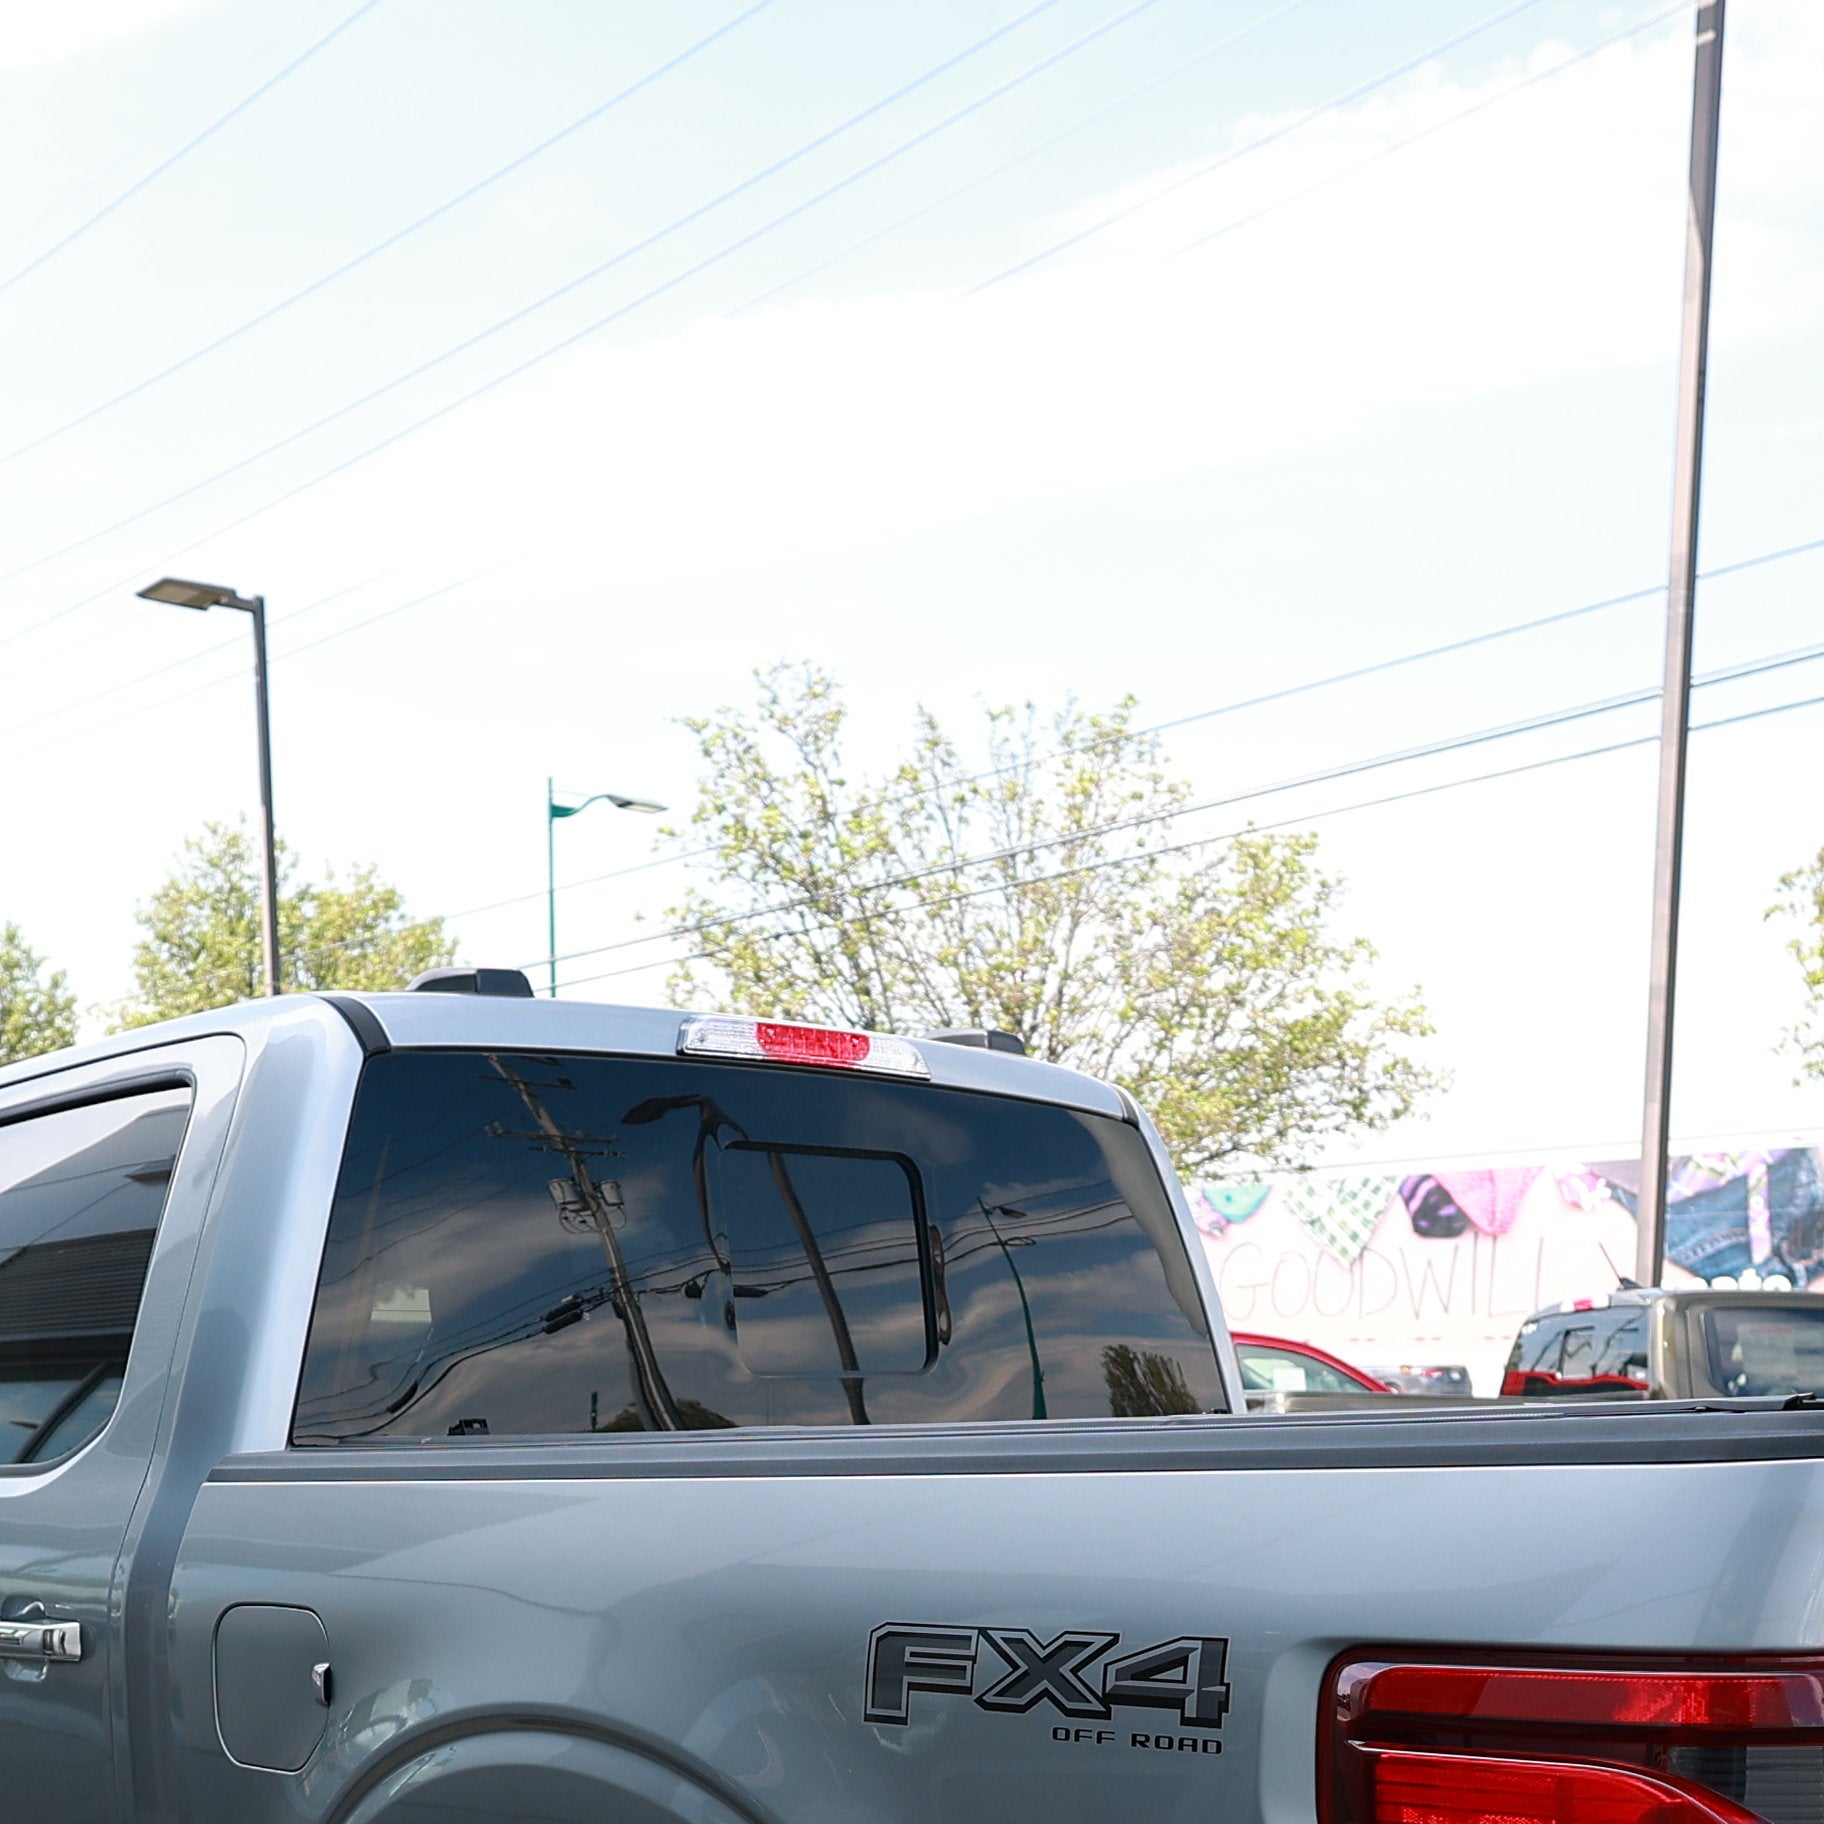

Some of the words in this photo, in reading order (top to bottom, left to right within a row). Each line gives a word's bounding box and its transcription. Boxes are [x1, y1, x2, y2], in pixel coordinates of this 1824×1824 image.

[862, 1621, 1231, 1729] FX4
[1051, 1727, 1116, 1745] OFF
[1130, 1732, 1223, 1756] ROAD
